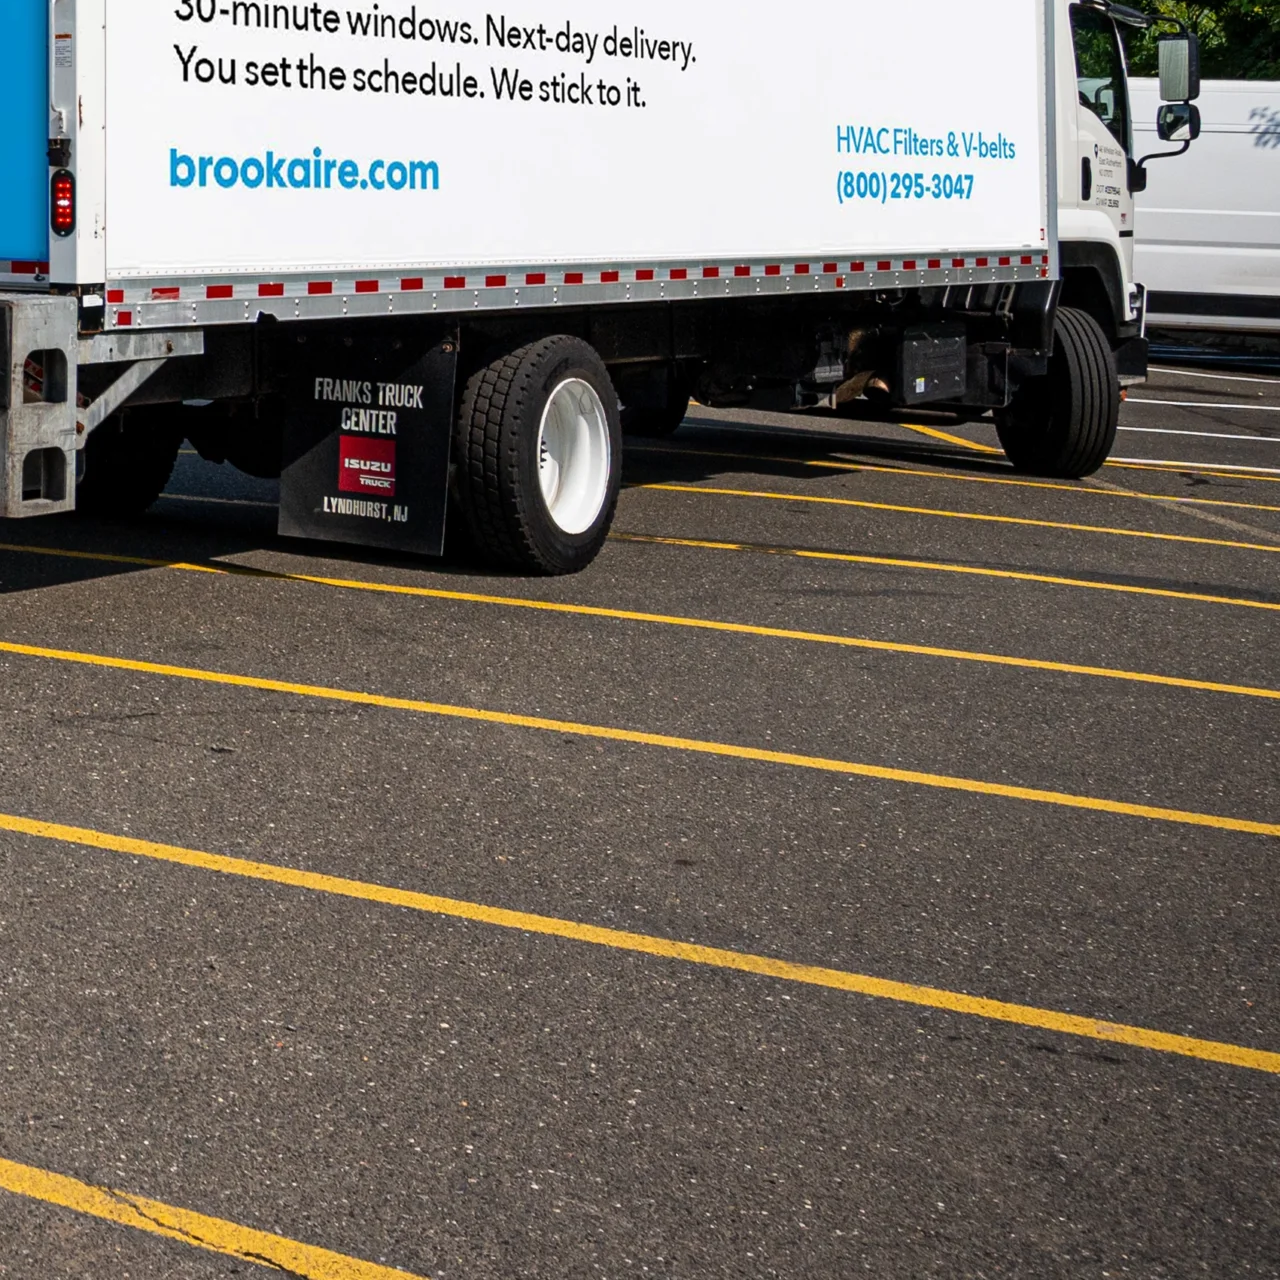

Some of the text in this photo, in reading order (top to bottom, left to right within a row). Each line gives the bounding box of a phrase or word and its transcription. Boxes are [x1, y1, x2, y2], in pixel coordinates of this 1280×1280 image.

[346, 4, 479, 45] windows.
[486, 14, 598, 65] Next-day
[602, 25, 697, 71] delivery.
[173, 44, 646, 108] You set the schedule. We stick to it.
[836, 125, 1016, 160] HVAC Filters & V-belts
[169, 147, 440, 190] brookaire.com
[836, 170, 974, 205] (800) 295-3047
[315, 378, 423, 408] FRANKS TRUCK
[341, 407, 397, 434] CENTER
[344, 458, 391, 472] ISUZU
[360, 478, 391, 488] TRUCK
[323, 496, 408, 522] LYNDHURST, NJ
